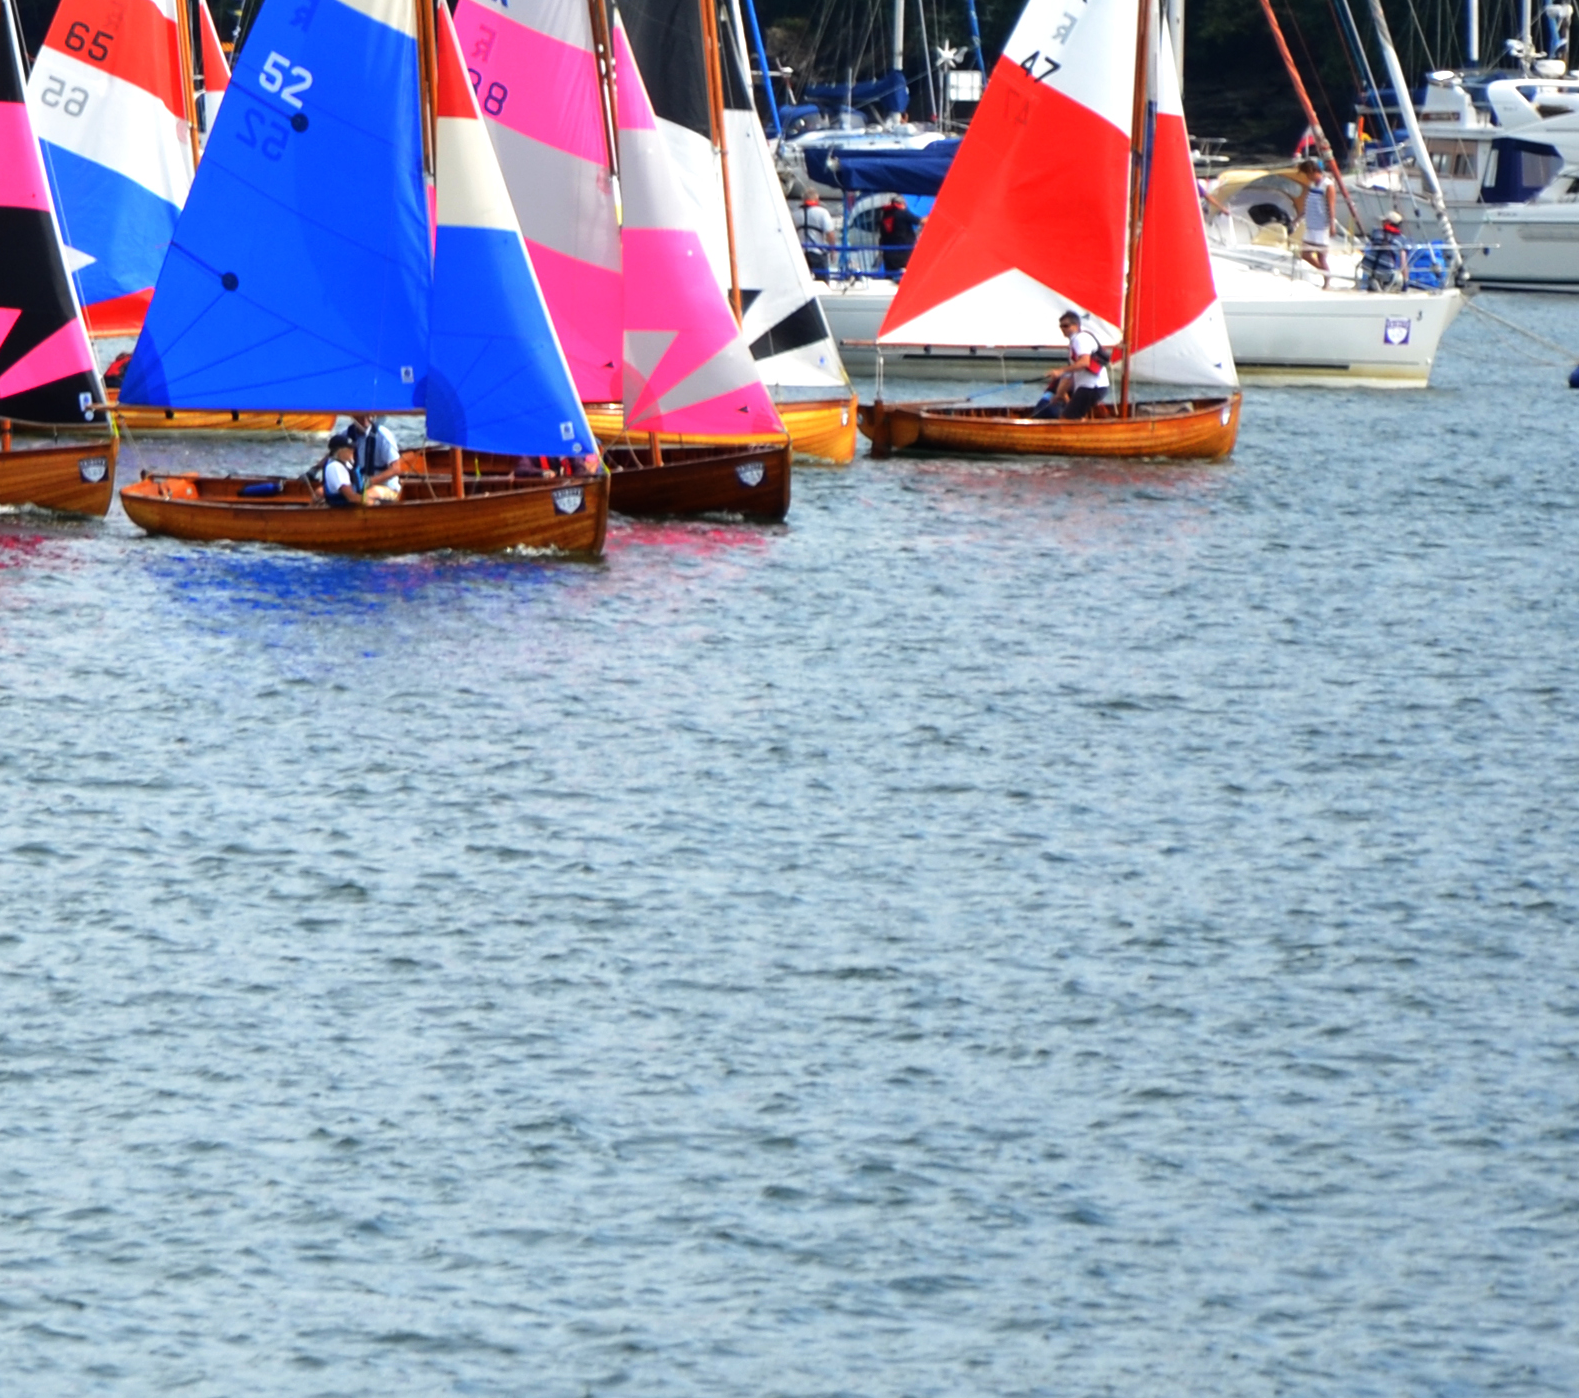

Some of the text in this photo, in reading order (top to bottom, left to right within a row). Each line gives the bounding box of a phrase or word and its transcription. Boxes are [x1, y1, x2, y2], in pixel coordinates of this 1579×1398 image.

[64, 20, 114, 62] 65
[258, 50, 313, 110] 52
[1019, 50, 1062, 84] 47
